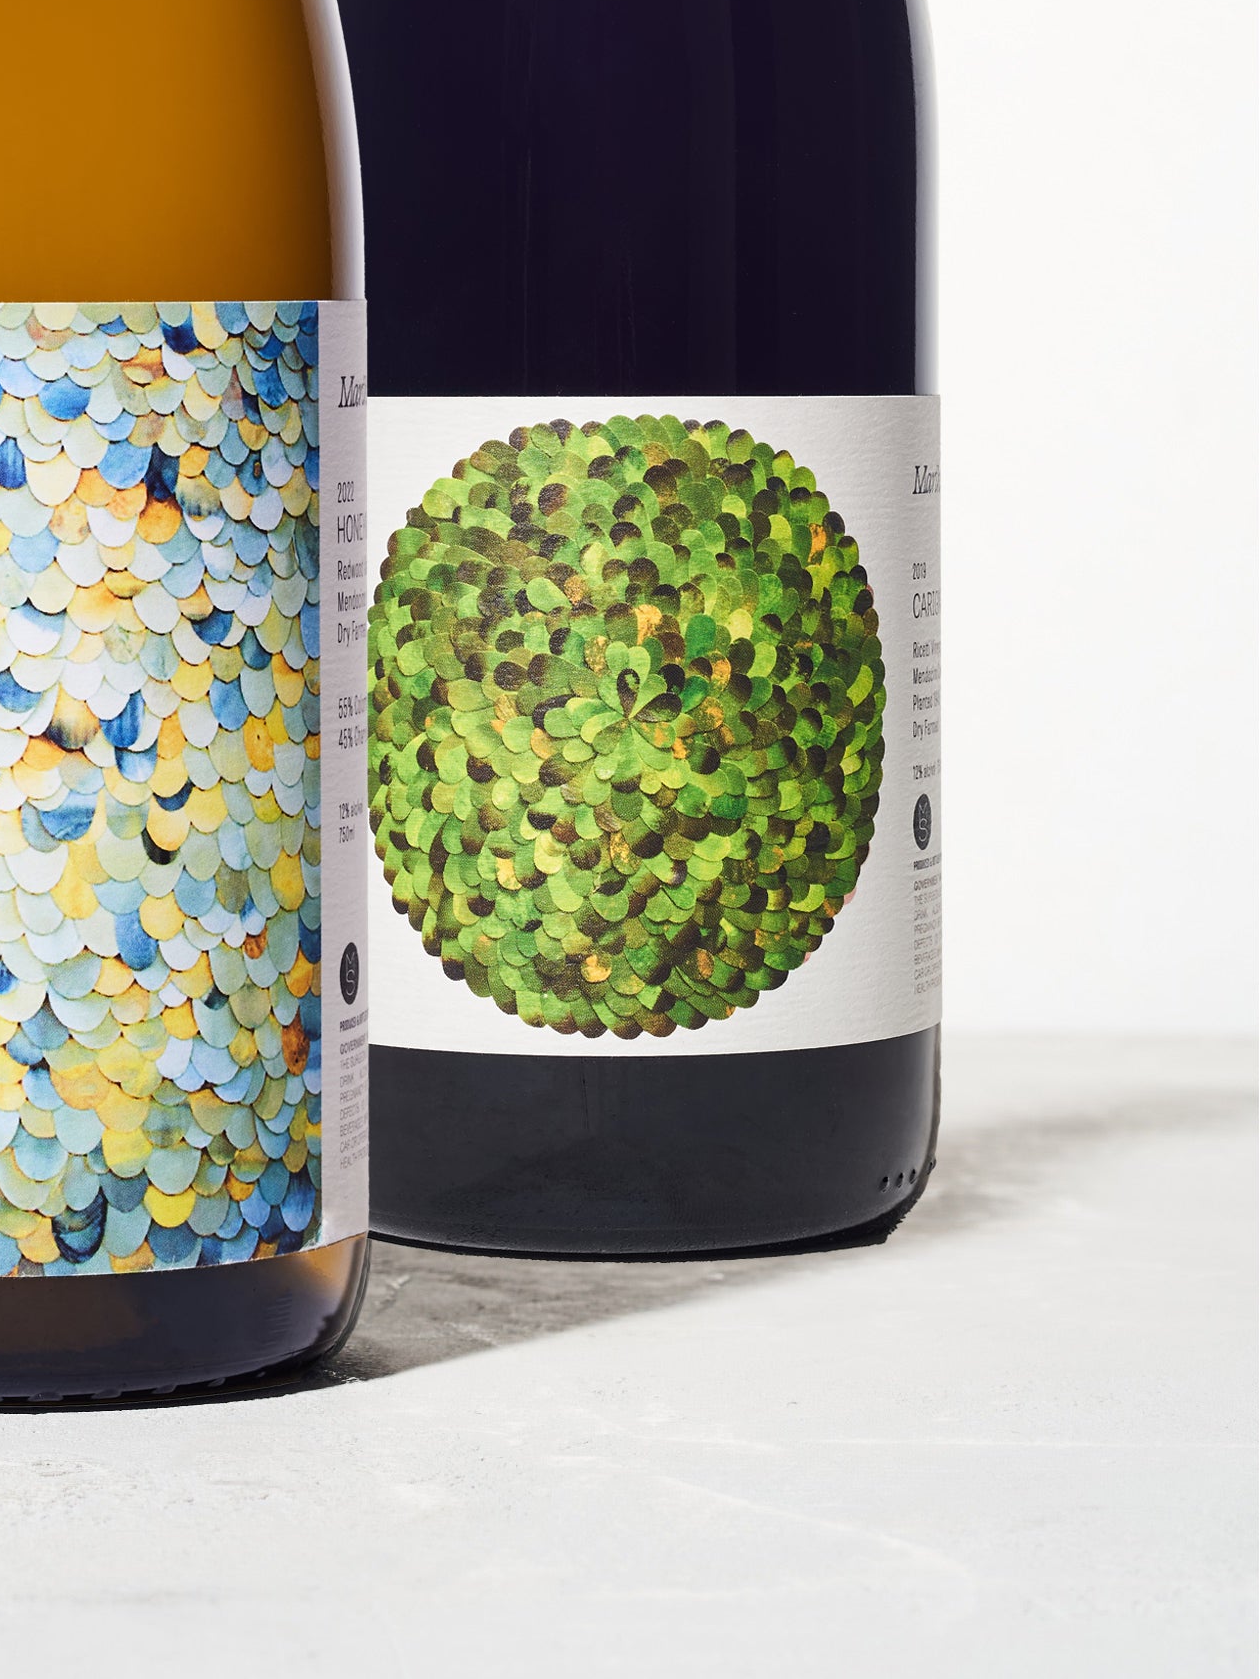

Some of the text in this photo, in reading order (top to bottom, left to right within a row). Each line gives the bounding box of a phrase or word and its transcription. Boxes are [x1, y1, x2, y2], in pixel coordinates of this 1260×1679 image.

[337, 480, 355, 503] 2022
[337, 512, 366, 544] HONE
[912, 590, 940, 619] CARIG
[337, 622, 351, 647] Dry
[338, 695, 353, 719] 55%
[338, 725, 353, 749] 45%
[912, 721, 923, 741] Dry
[338, 802, 349, 820] 12%
